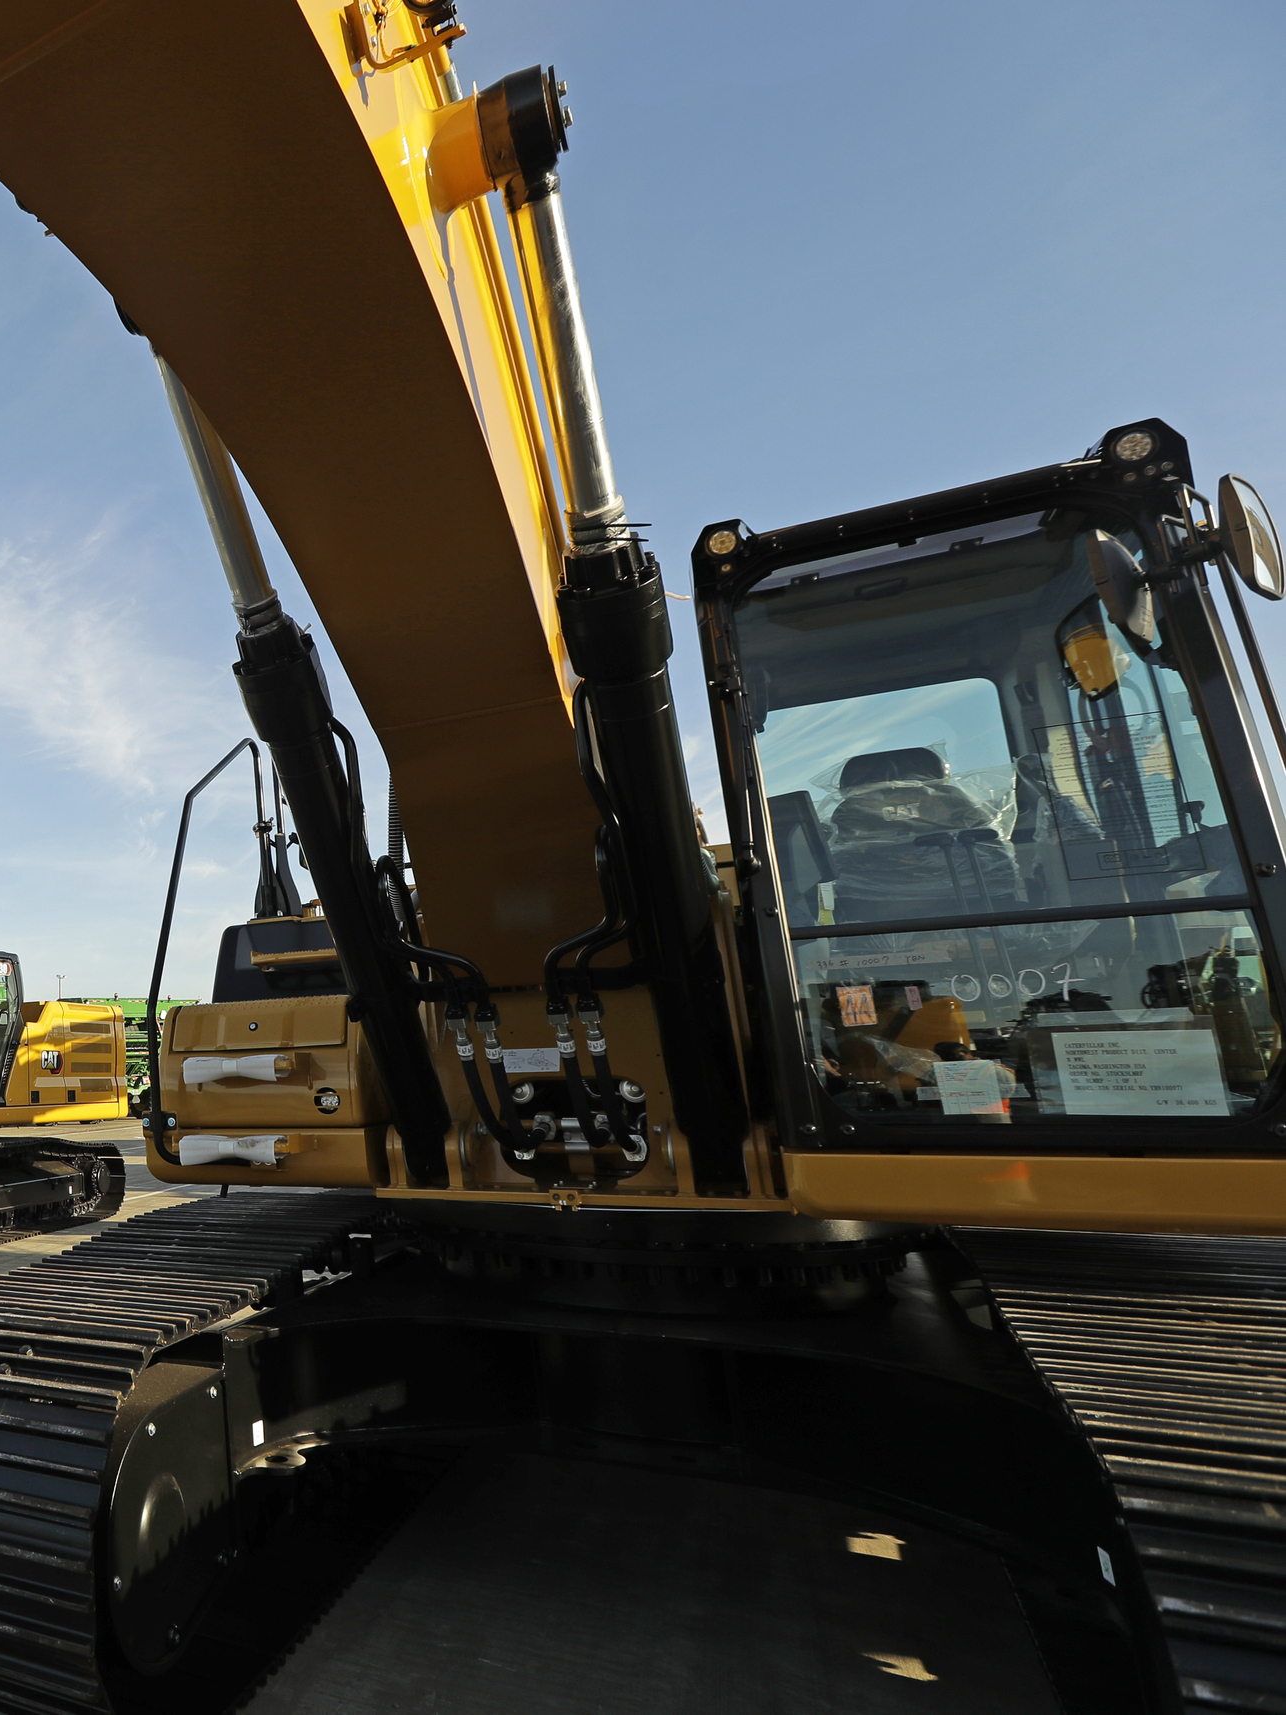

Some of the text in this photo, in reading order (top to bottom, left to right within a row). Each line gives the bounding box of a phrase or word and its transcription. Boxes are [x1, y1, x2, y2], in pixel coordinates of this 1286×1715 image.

[882, 802, 920, 821] CAT
[816, 960, 834, 970] 336
[857, 955, 889, 966] 10007
[951, 963, 1086, 1002] 0007
[41, 1051, 59, 1069] CAT
